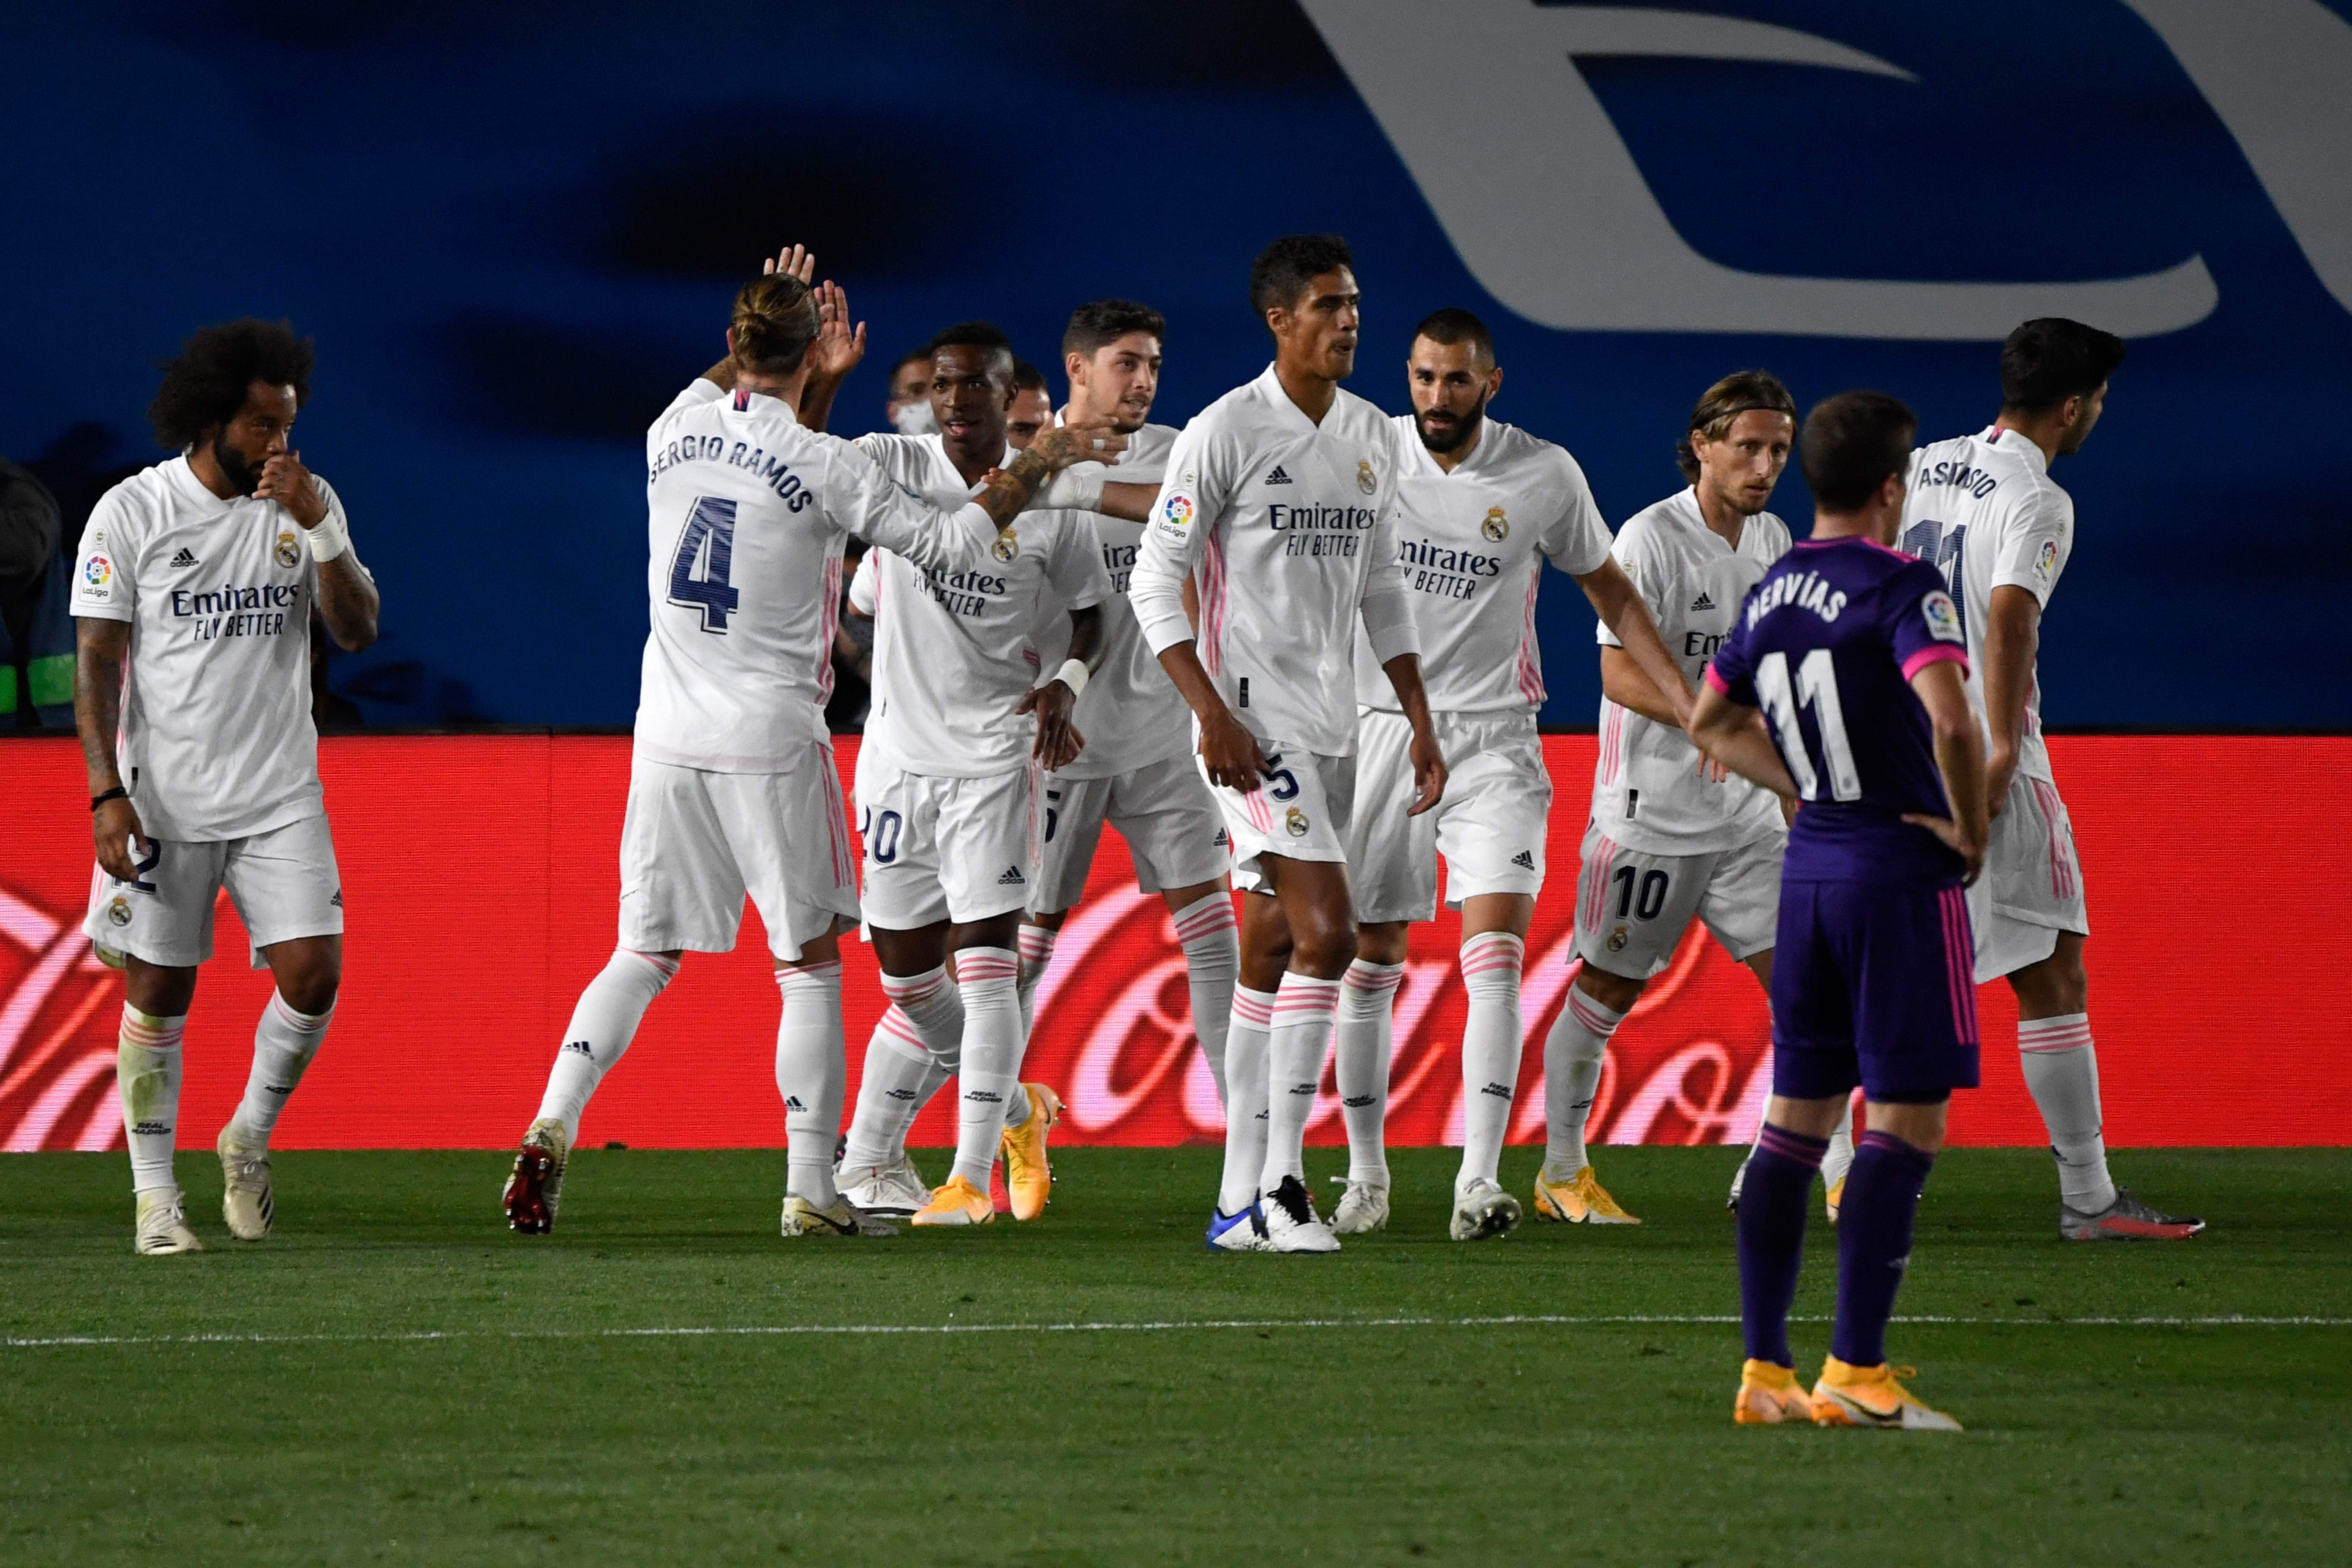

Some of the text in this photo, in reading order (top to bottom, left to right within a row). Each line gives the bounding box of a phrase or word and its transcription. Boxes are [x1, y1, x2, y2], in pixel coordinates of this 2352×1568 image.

[651, 435, 813, 514] SERGIO RAMOS
[1159, 522, 1187, 538] LaLiga
[1269, 501, 1376, 531] Emirates
[1286, 534, 1309, 556] FLY
[1399, 538, 1501, 577] mirates
[170, 560, 200, 568] adidas
[666, 495, 739, 635] 4
[82, 587, 109, 597] LaLiga
[171, 583, 300, 617] Emirates
[1414, 570, 1476, 600] BETTER
[1747, 569, 1848, 632] NERVÍAS
[194, 613, 283, 641] FLY BETTER
[1754, 648, 1862, 802] 11
[1255, 753, 1299, 803] 5
[1613, 865, 1669, 921] 10
[964, 1095, 1003, 1103] MADRID
